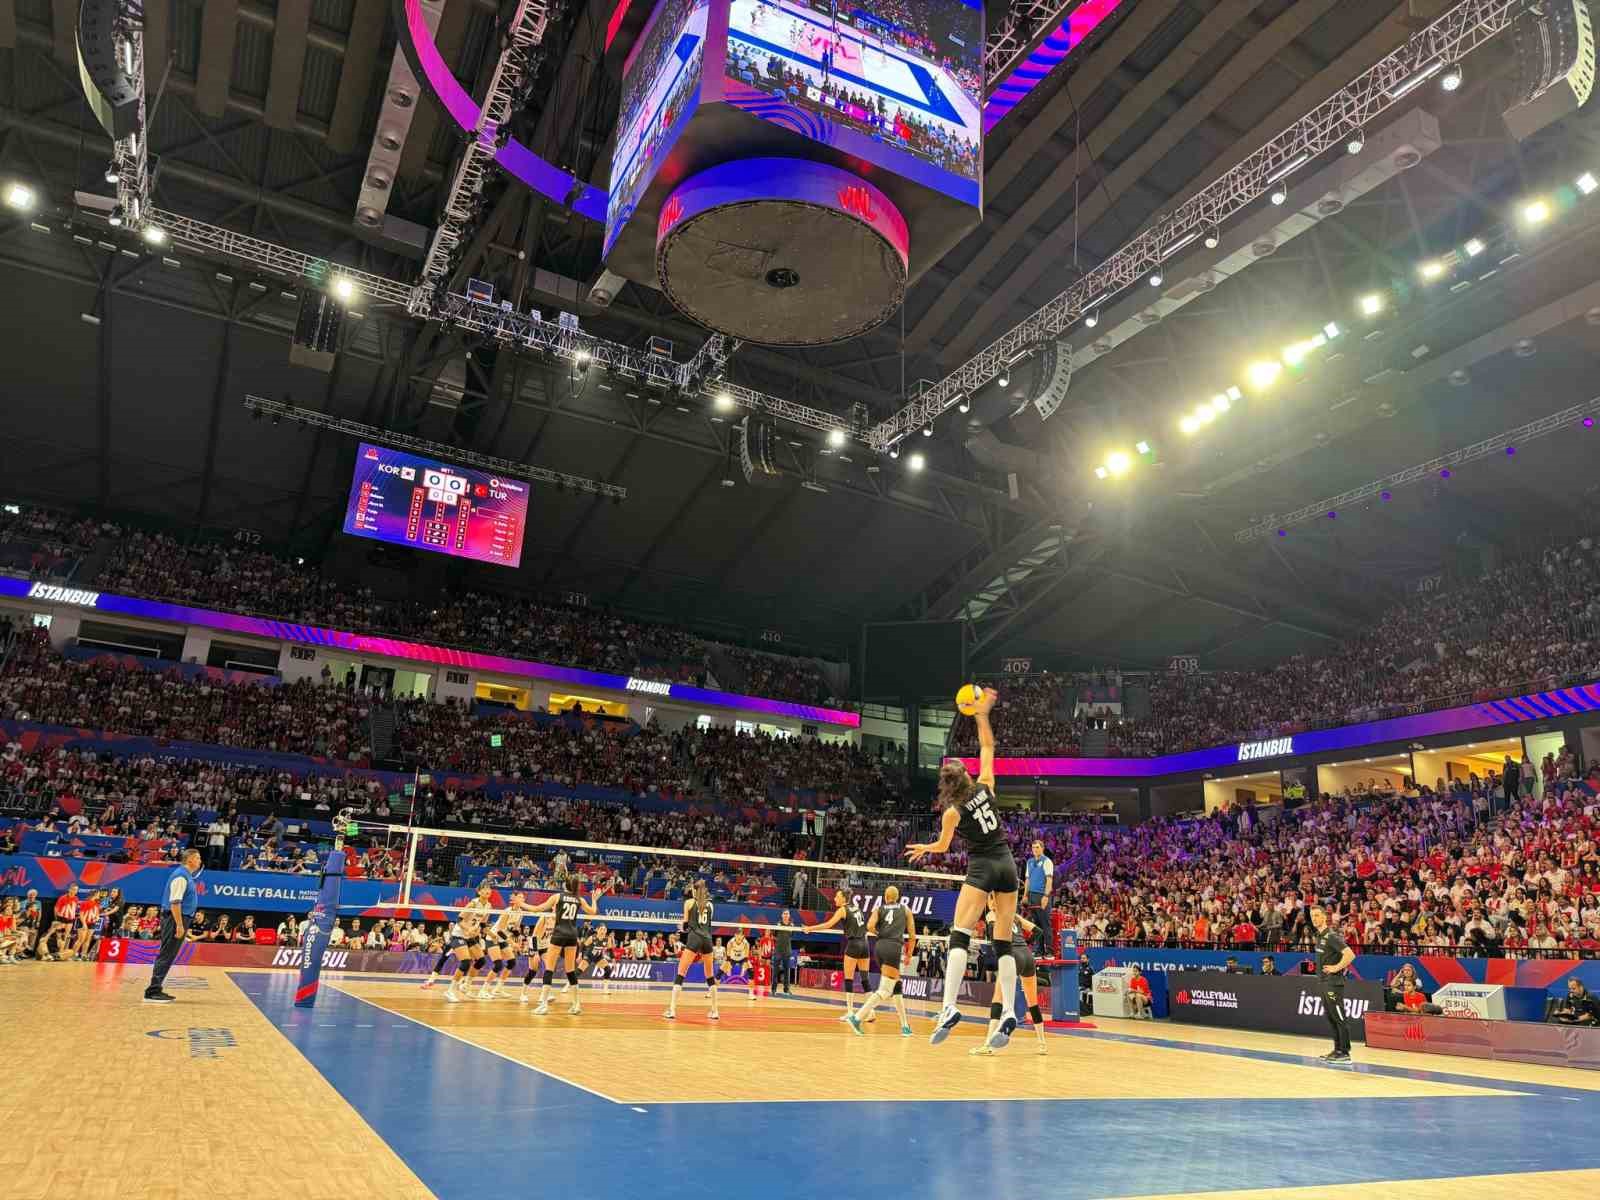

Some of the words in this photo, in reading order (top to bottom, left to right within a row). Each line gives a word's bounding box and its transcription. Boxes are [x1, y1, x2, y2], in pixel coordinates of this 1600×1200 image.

[378, 464, 401, 476] KOR
[429, 475, 440, 486] 0
[450, 480, 460, 490] 0
[489, 489, 508, 501] TUR
[1004, 661, 1031, 673] 409
[1169, 659, 1200, 671] 408
[1238, 737, 1293, 761] İSTANBUL
[972, 802, 998, 834] 15
[213, 884, 297, 900] VOLLEYBALL
[561, 903, 577, 920] 20
[885, 909, 894, 925] 4
[107, 940, 120, 957] 3
[272, 946, 349, 968] İSTBUL
[758, 967, 765, 981] 3
[1191, 989, 1238, 1001] VOLLEYBALL
[1191, 998, 1215, 1007] NATIONS
[1216, 1000, 1238, 1009] LEAGUE
